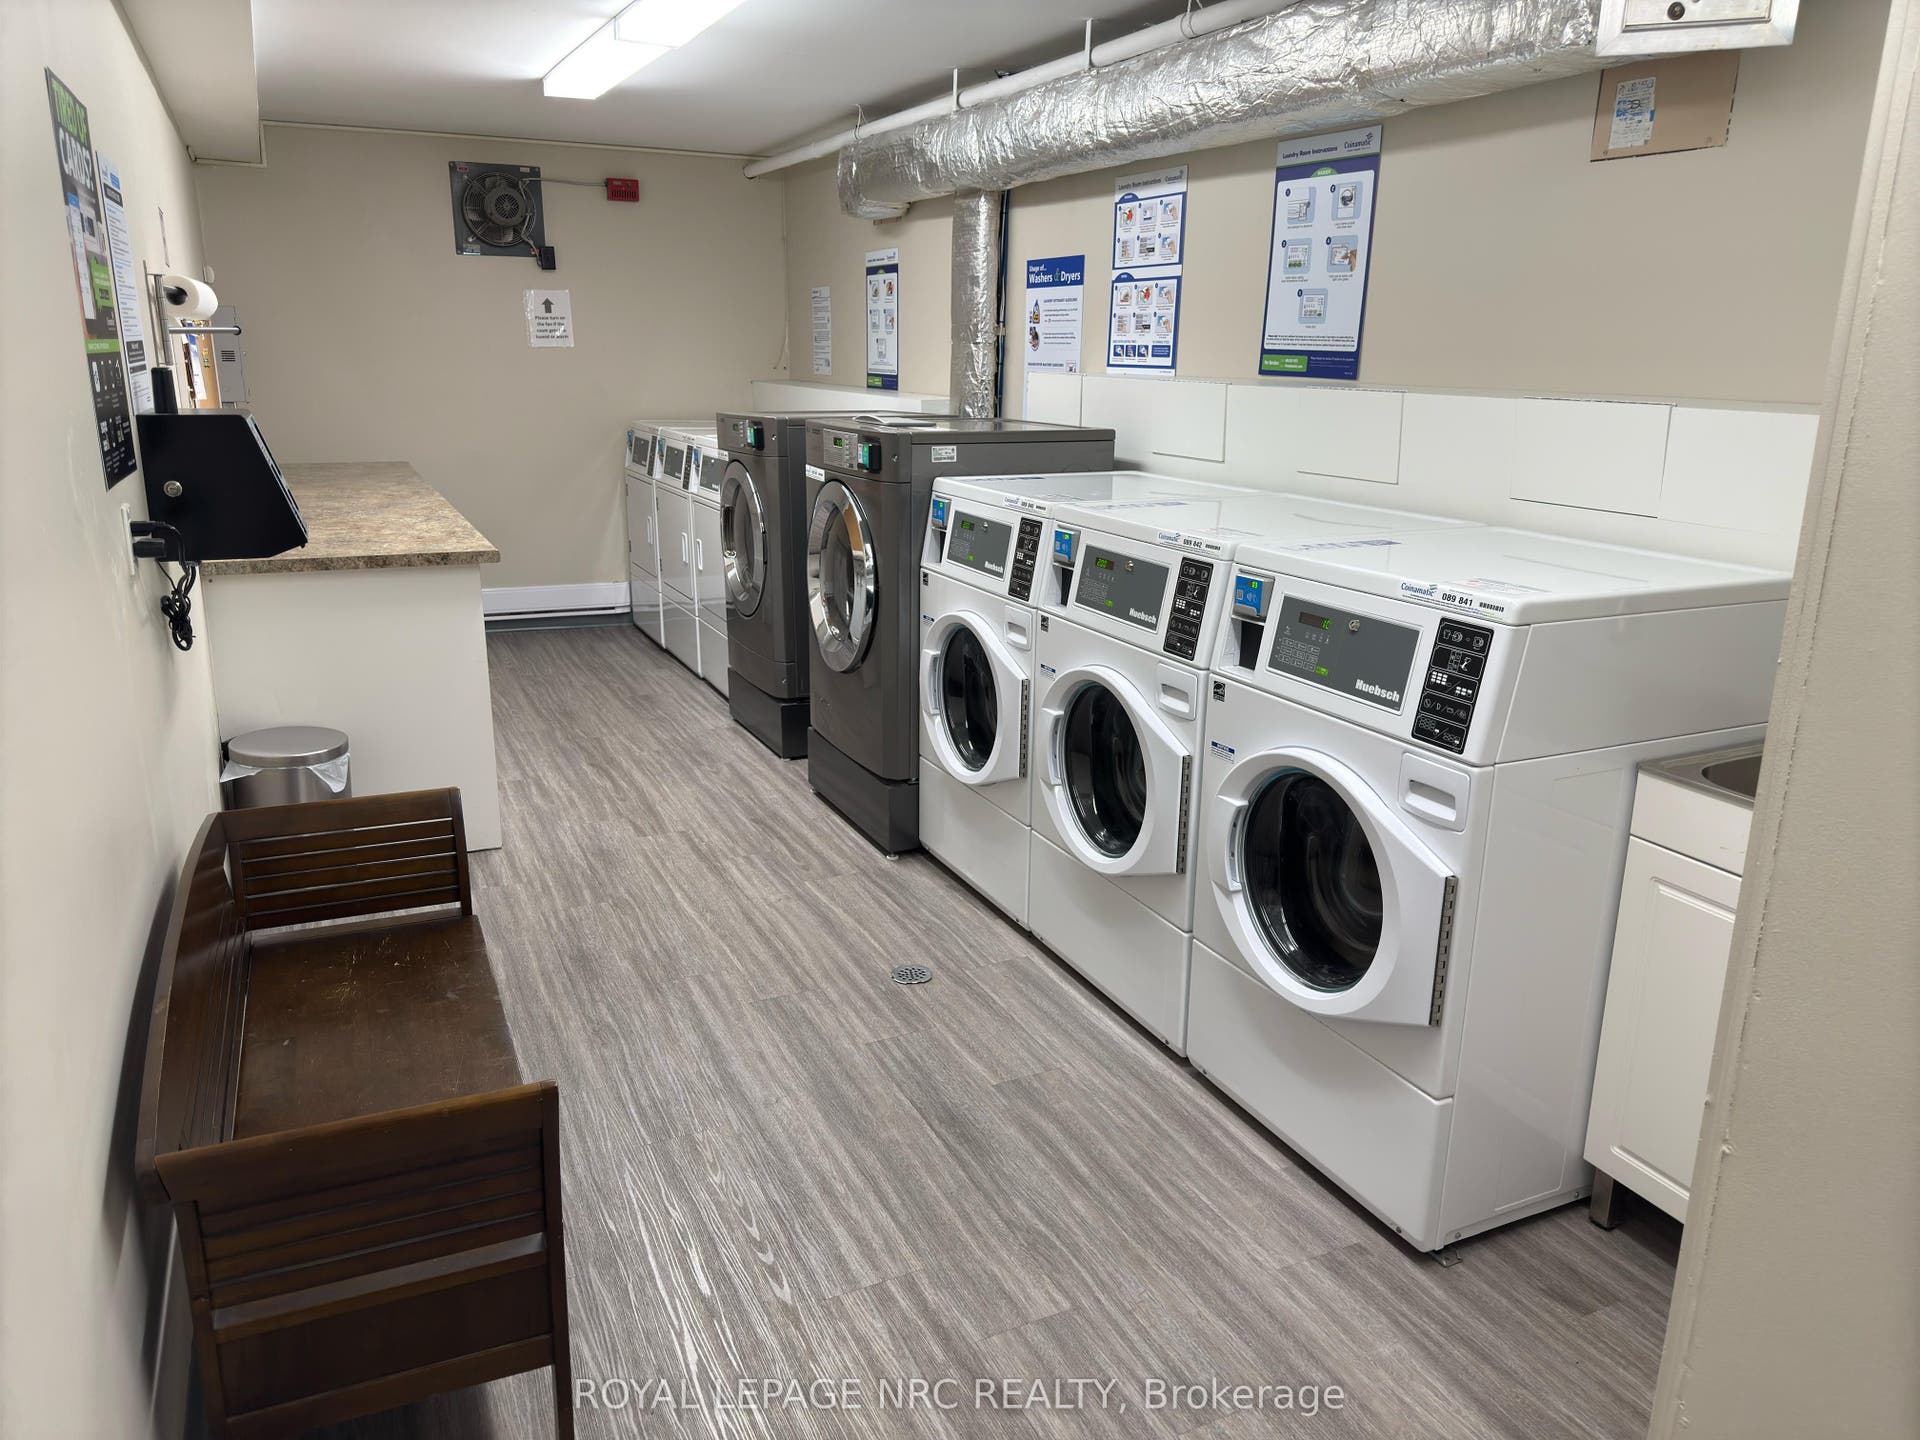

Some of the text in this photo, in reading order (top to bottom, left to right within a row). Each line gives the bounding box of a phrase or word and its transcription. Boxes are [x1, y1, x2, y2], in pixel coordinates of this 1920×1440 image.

[59, 127, 94, 192] CARDS?
[1282, 151, 1299, 159] Laundry
[1029, 273, 1053, 284] Washers
[1060, 270, 1081, 284] Dryers
[1401, 582, 1435, 597] Coinamatic
[1442, 592, 1457, 603] 089
[1458, 596, 1473, 607] 841
[1129, 607, 1157, 625] Huebsch
[1355, 678, 1400, 703] Huebsch
